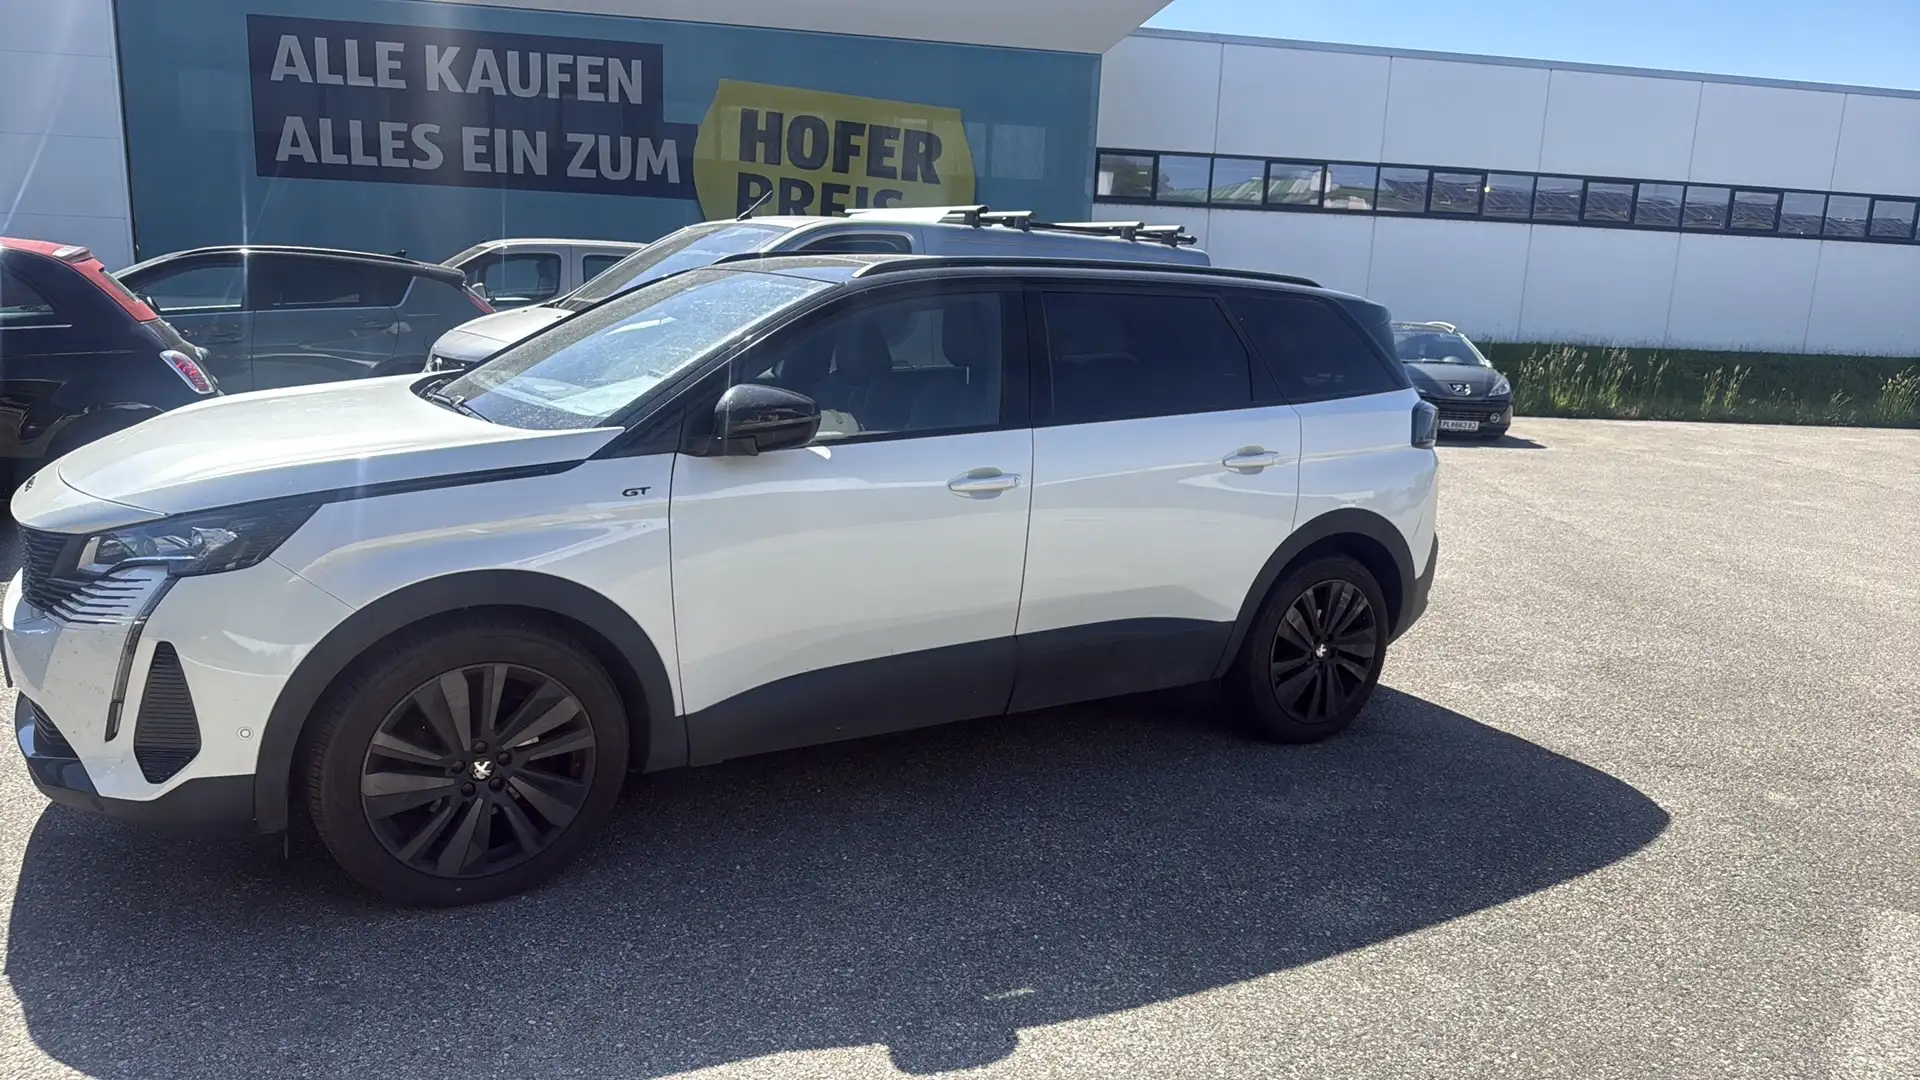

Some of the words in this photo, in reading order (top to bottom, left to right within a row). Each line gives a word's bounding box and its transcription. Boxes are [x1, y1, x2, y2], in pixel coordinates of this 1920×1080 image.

[271, 34, 406, 89] ALLE
[425, 44, 642, 104] KAUFEN
[275, 116, 444, 170] ALLES
[461, 126, 547, 175] EIN
[566, 133, 680, 183] ZUM
[739, 107, 942, 184] HOFER
[622, 486, 651, 497] GT
